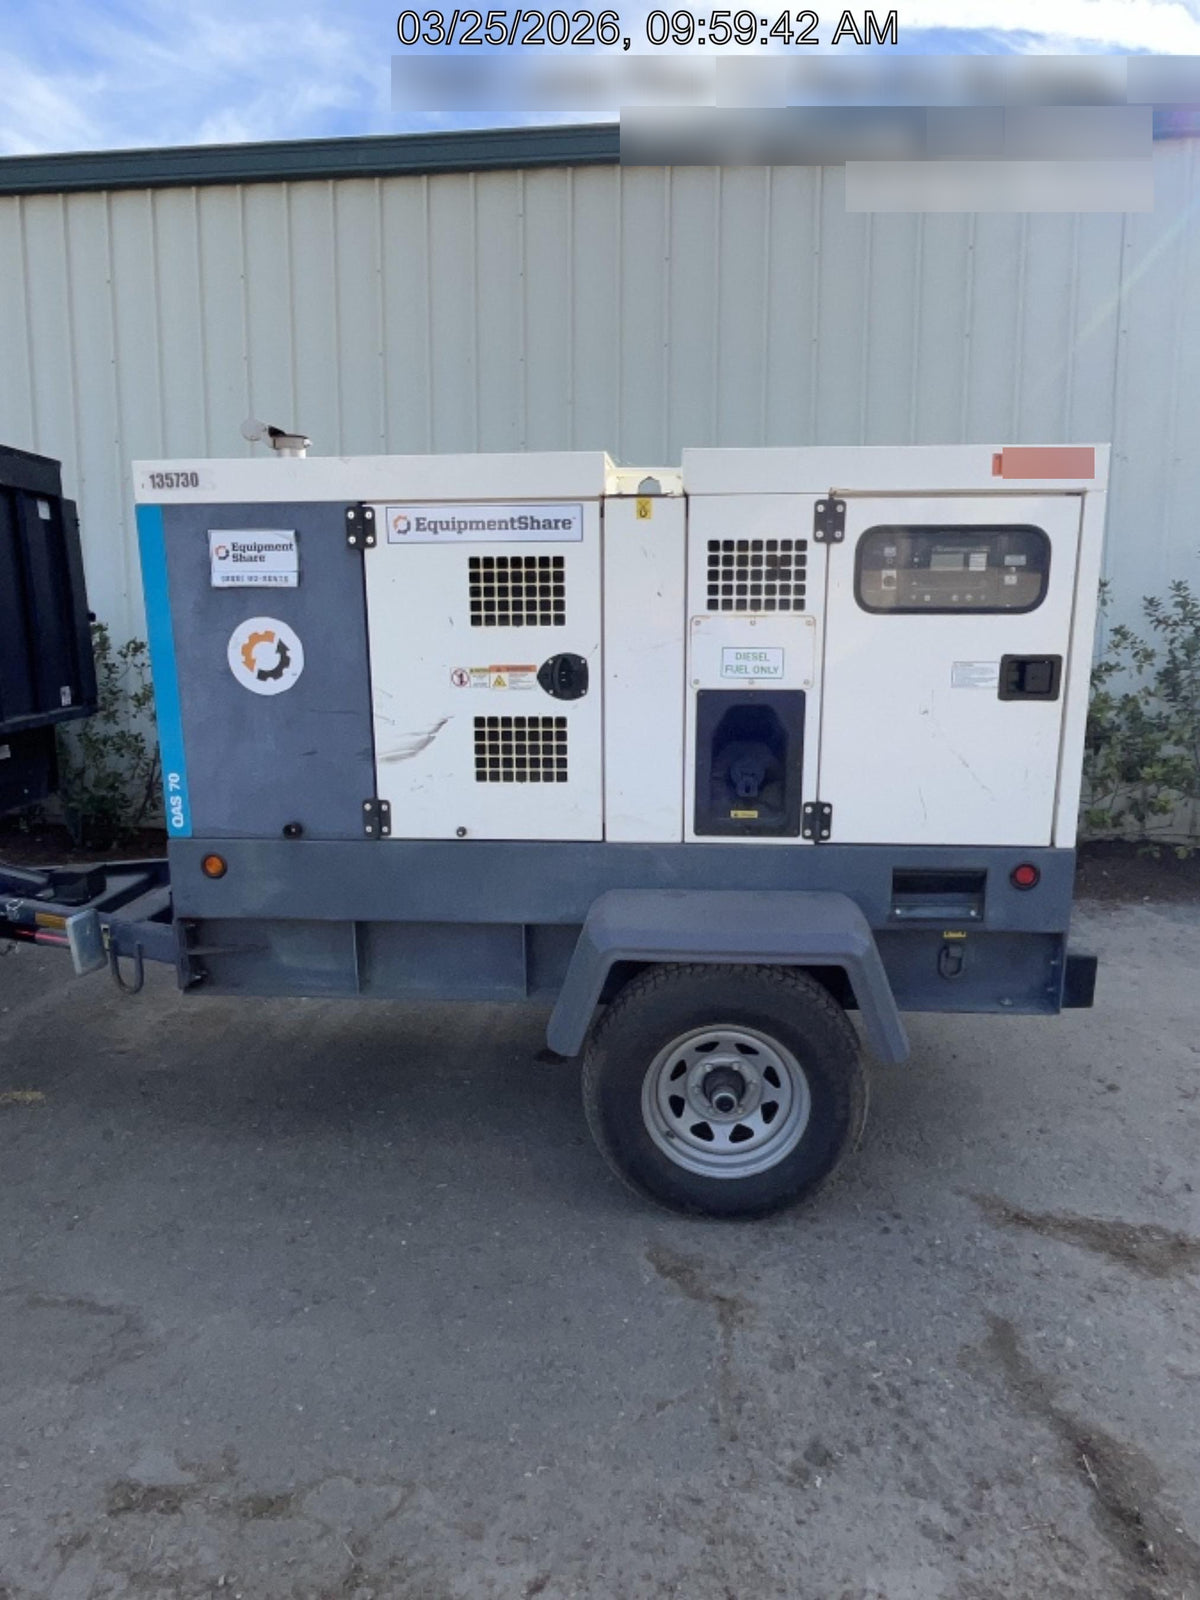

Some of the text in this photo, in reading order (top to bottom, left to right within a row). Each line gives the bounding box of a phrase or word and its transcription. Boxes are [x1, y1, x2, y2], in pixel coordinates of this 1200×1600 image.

[149, 471, 199, 489] 135730
[415, 515, 572, 534] EquipmentShare
[231, 541, 293, 553] Equipment
[232, 552, 266, 562] Share
[735, 652, 770, 661] DIESEL
[725, 664, 779, 674] FUEL ONLY
[168, 772, 183, 828] QAS 70
